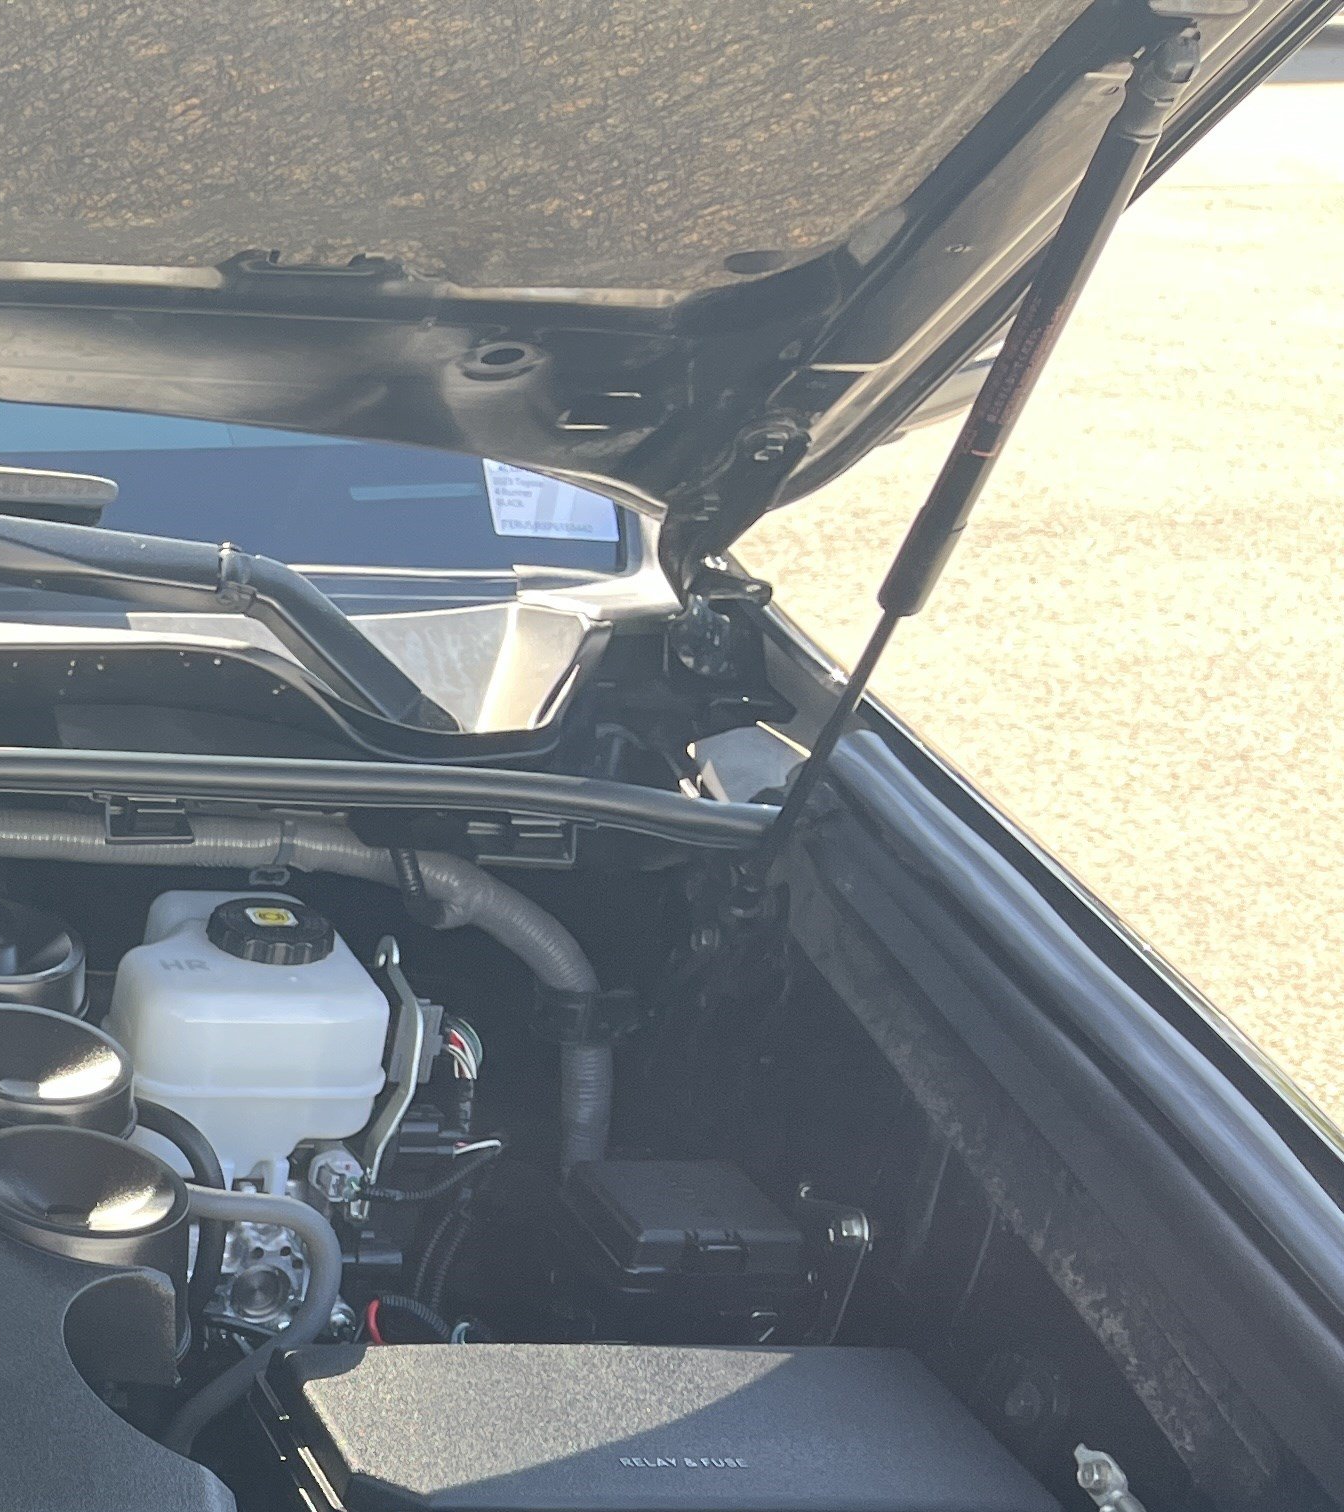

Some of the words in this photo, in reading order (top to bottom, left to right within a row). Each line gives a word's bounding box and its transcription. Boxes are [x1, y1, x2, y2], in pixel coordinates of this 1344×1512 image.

[159, 958, 210, 971] HR
[619, 1457, 677, 1467] RELAY
[683, 1457, 698, 1467] &
[700, 1457, 751, 1468] FUSE
